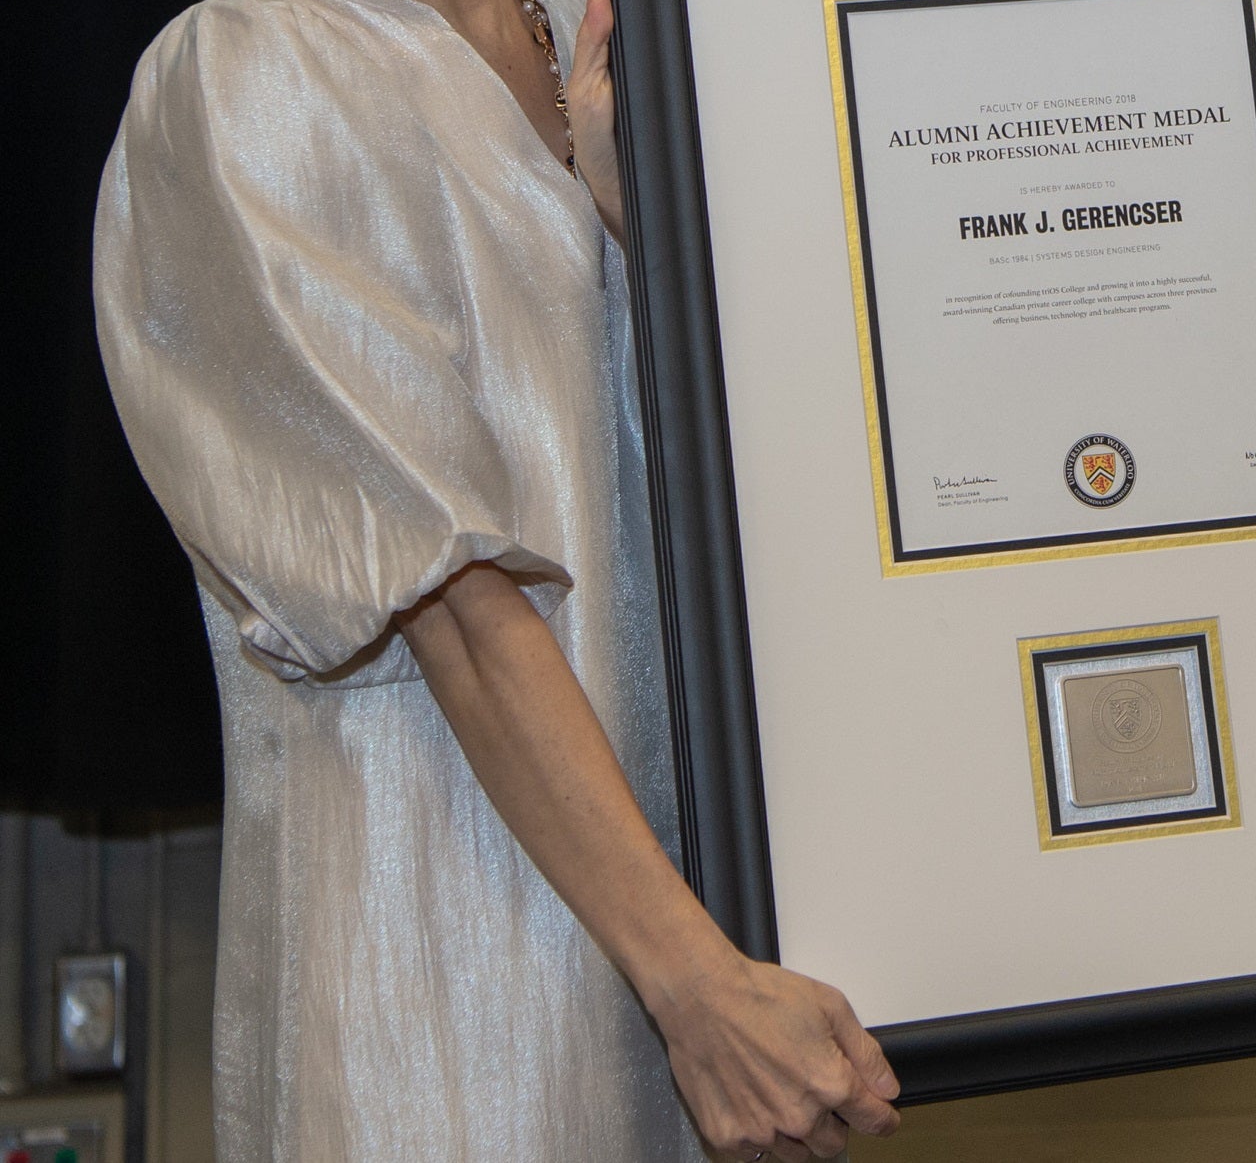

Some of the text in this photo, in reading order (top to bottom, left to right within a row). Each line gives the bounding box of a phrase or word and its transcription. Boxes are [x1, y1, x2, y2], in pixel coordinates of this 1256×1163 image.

[980, 93, 1137, 113] FACULTY OF ENGINEERING 2018
[888, 106, 1231, 148] ALUMNI ACHIEVEMENT MEDAL
[931, 133, 1195, 165] FOR PROFESSIONAL ACHIEVEMENT
[1019, 180, 1116, 195] IS HEREBY AWARDED TO
[959, 200, 1183, 240] FRANK J. GERENCSER
[1036, 250, 1073, 261] SYSTEMS
[1074, 248, 1105, 258] DESIGN
[1106, 243, 1161, 255] ENGINEERING
[942, 306, 993, 317] award-winning
[993, 302, 1026, 312] Canadian
[1027, 300, 1051, 311] private
[1051, 299, 1072, 307] career
[1072, 296, 1097, 306] college
[1097, 294, 1113, 302] with
[1113, 293, 1146, 303] campuses
[1167, 288, 1186, 296] three
[1186, 286, 1218, 297] provinces
[954, 293, 993, 304] recognition
[994, 291, 1002, 299] of
[1002, 288, 1041, 298] cofounding
[1060, 285, 1086, 294] College
[1101, 281, 1128, 291] growing
[1129, 279, 1135, 287] it
[1135, 279, 1150, 287] into
[1156, 276, 1178, 287] highly
[992, 316, 1020, 326] offering
[1050, 309, 1088, 321] technology
[1088, 309, 1102, 317] and
[1102, 306, 1137, 315] healthcare
[1138, 303, 1171, 314] programs.
[1066, 439, 1091, 485] UNIVERSITY
[1107, 438, 1134, 480] WATERLOO
